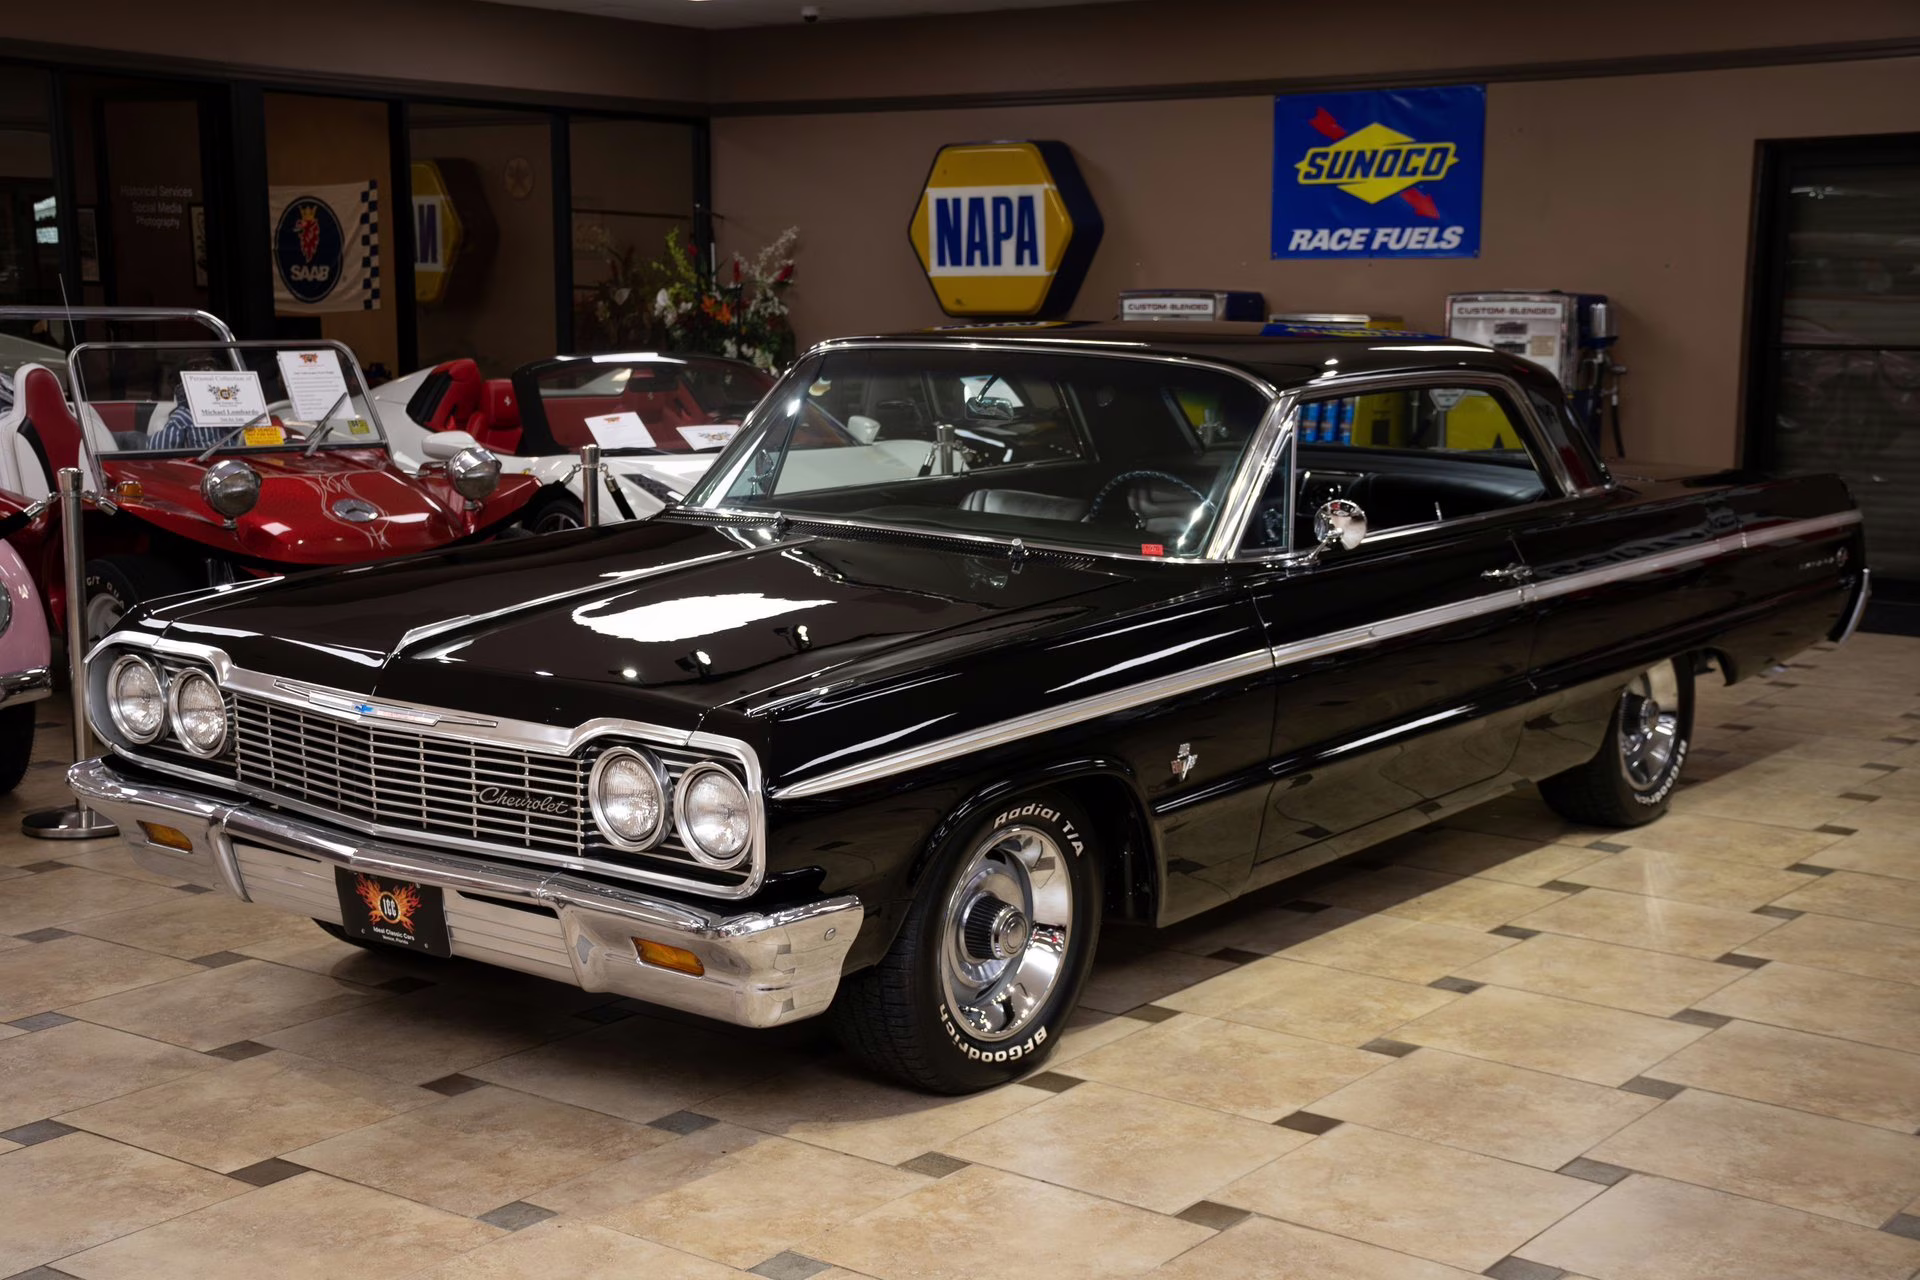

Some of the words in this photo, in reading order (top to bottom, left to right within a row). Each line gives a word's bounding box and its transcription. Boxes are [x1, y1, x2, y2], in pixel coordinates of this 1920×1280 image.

[1302, 146, 1451, 181] SUNOCO
[157, 200, 183, 214] Media
[936, 195, 1039, 267] NAPA
[1287, 227, 1371, 252] RACE
[1370, 225, 1465, 251] FUELS
[290, 264, 330, 282] SAAB
[479, 787, 569, 814] Chevrolet
[993, 803, 1061, 829] Radial
[1062, 820, 1084, 857] T/A
[382, 897, 397, 917] ICC
[385, 928, 403, 938] Classic
[403, 932, 415, 941] Cars
[939, 1003, 1048, 1063] BFGoodrich
